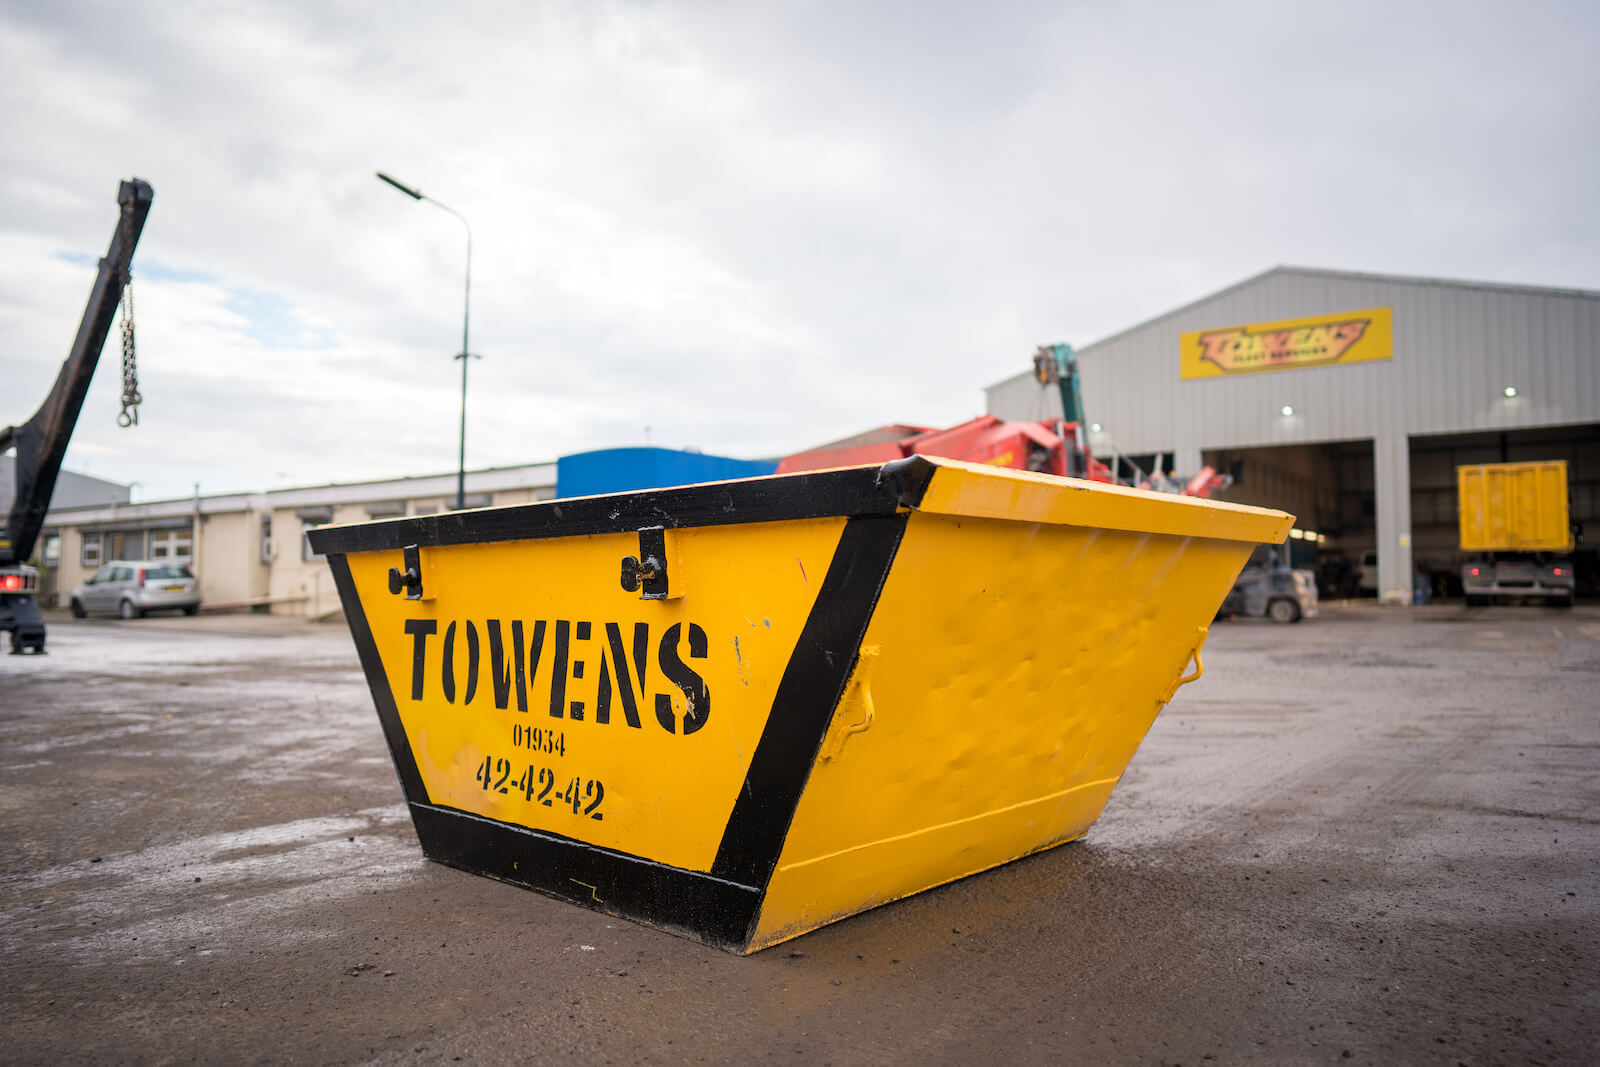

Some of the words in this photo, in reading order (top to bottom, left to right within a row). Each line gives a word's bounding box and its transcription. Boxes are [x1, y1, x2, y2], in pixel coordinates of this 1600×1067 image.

[404, 619, 710, 735] TOWENS
[513, 724, 566, 757] 01934
[476, 755, 605, 821] 42-42-42
